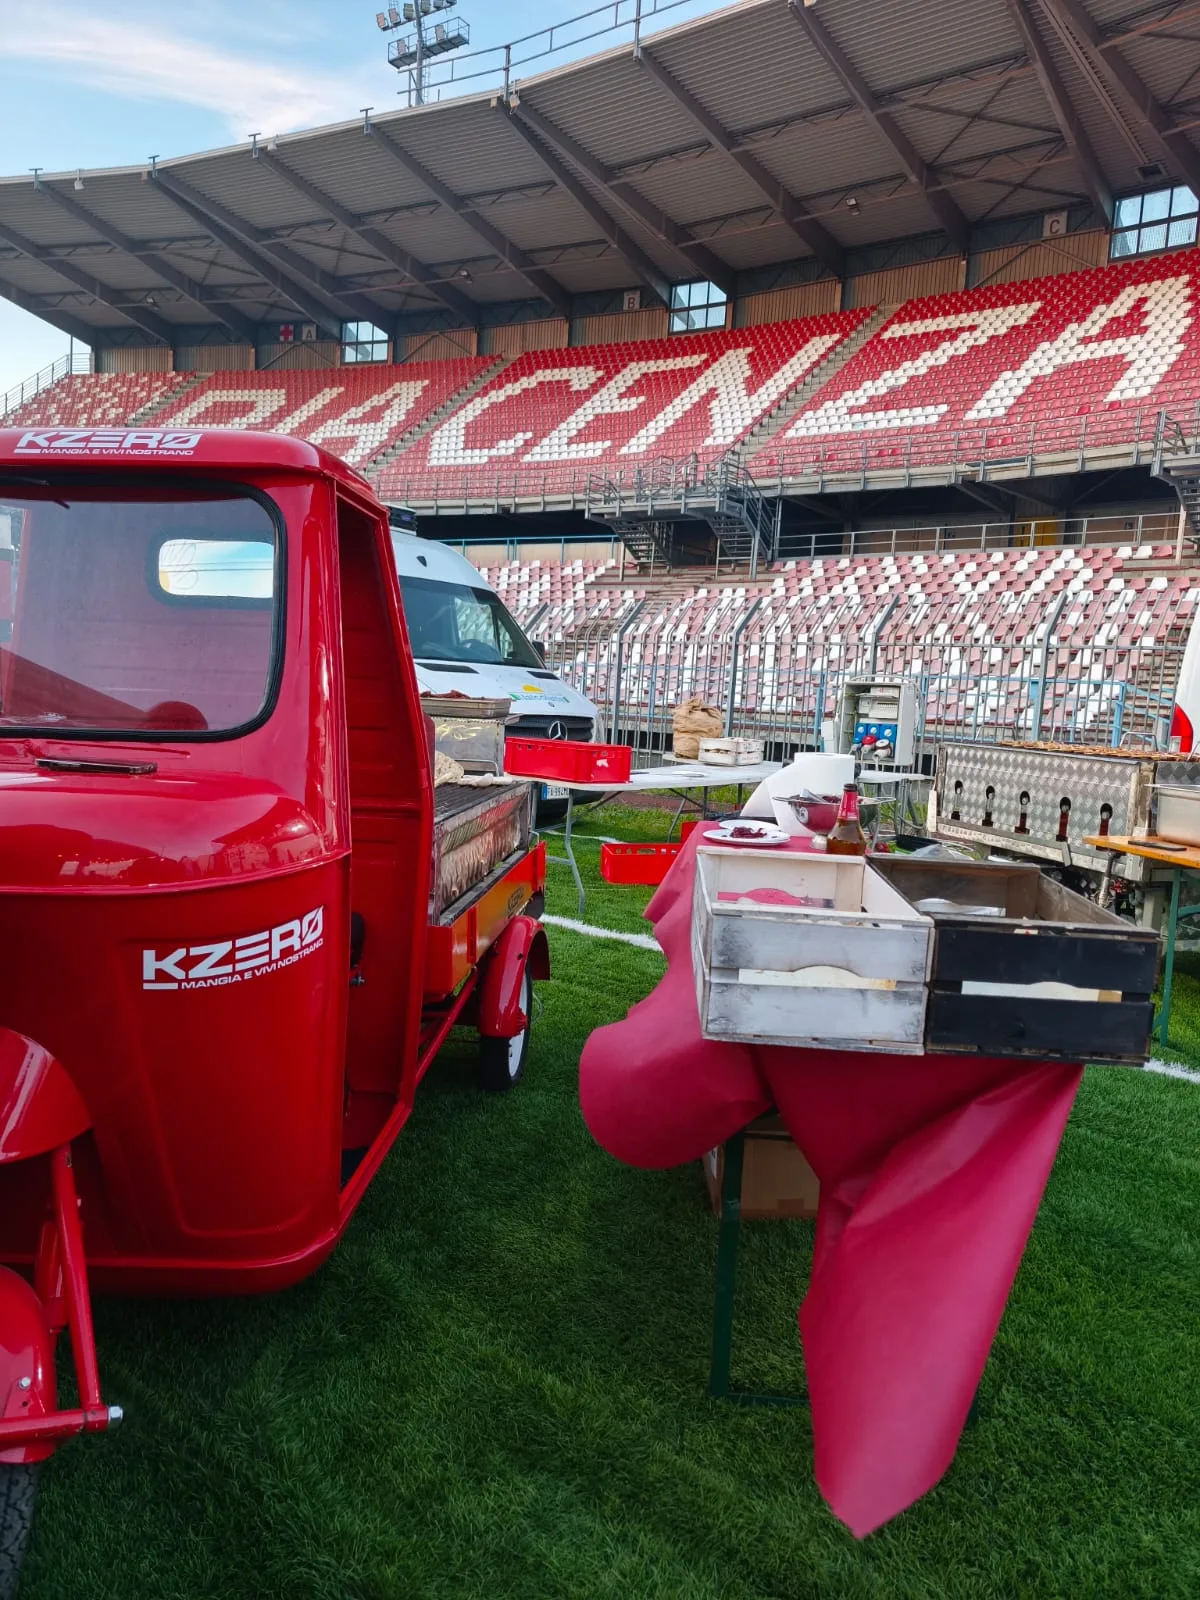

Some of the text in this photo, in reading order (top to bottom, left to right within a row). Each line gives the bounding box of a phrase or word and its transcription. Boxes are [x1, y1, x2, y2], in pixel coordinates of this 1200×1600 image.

[1049, 219, 1060, 234] C
[627, 297, 635, 309] B
[306, 328, 314, 339] A
[181, 938, 324, 990] MANGIA E VIVI NOSTRANO
